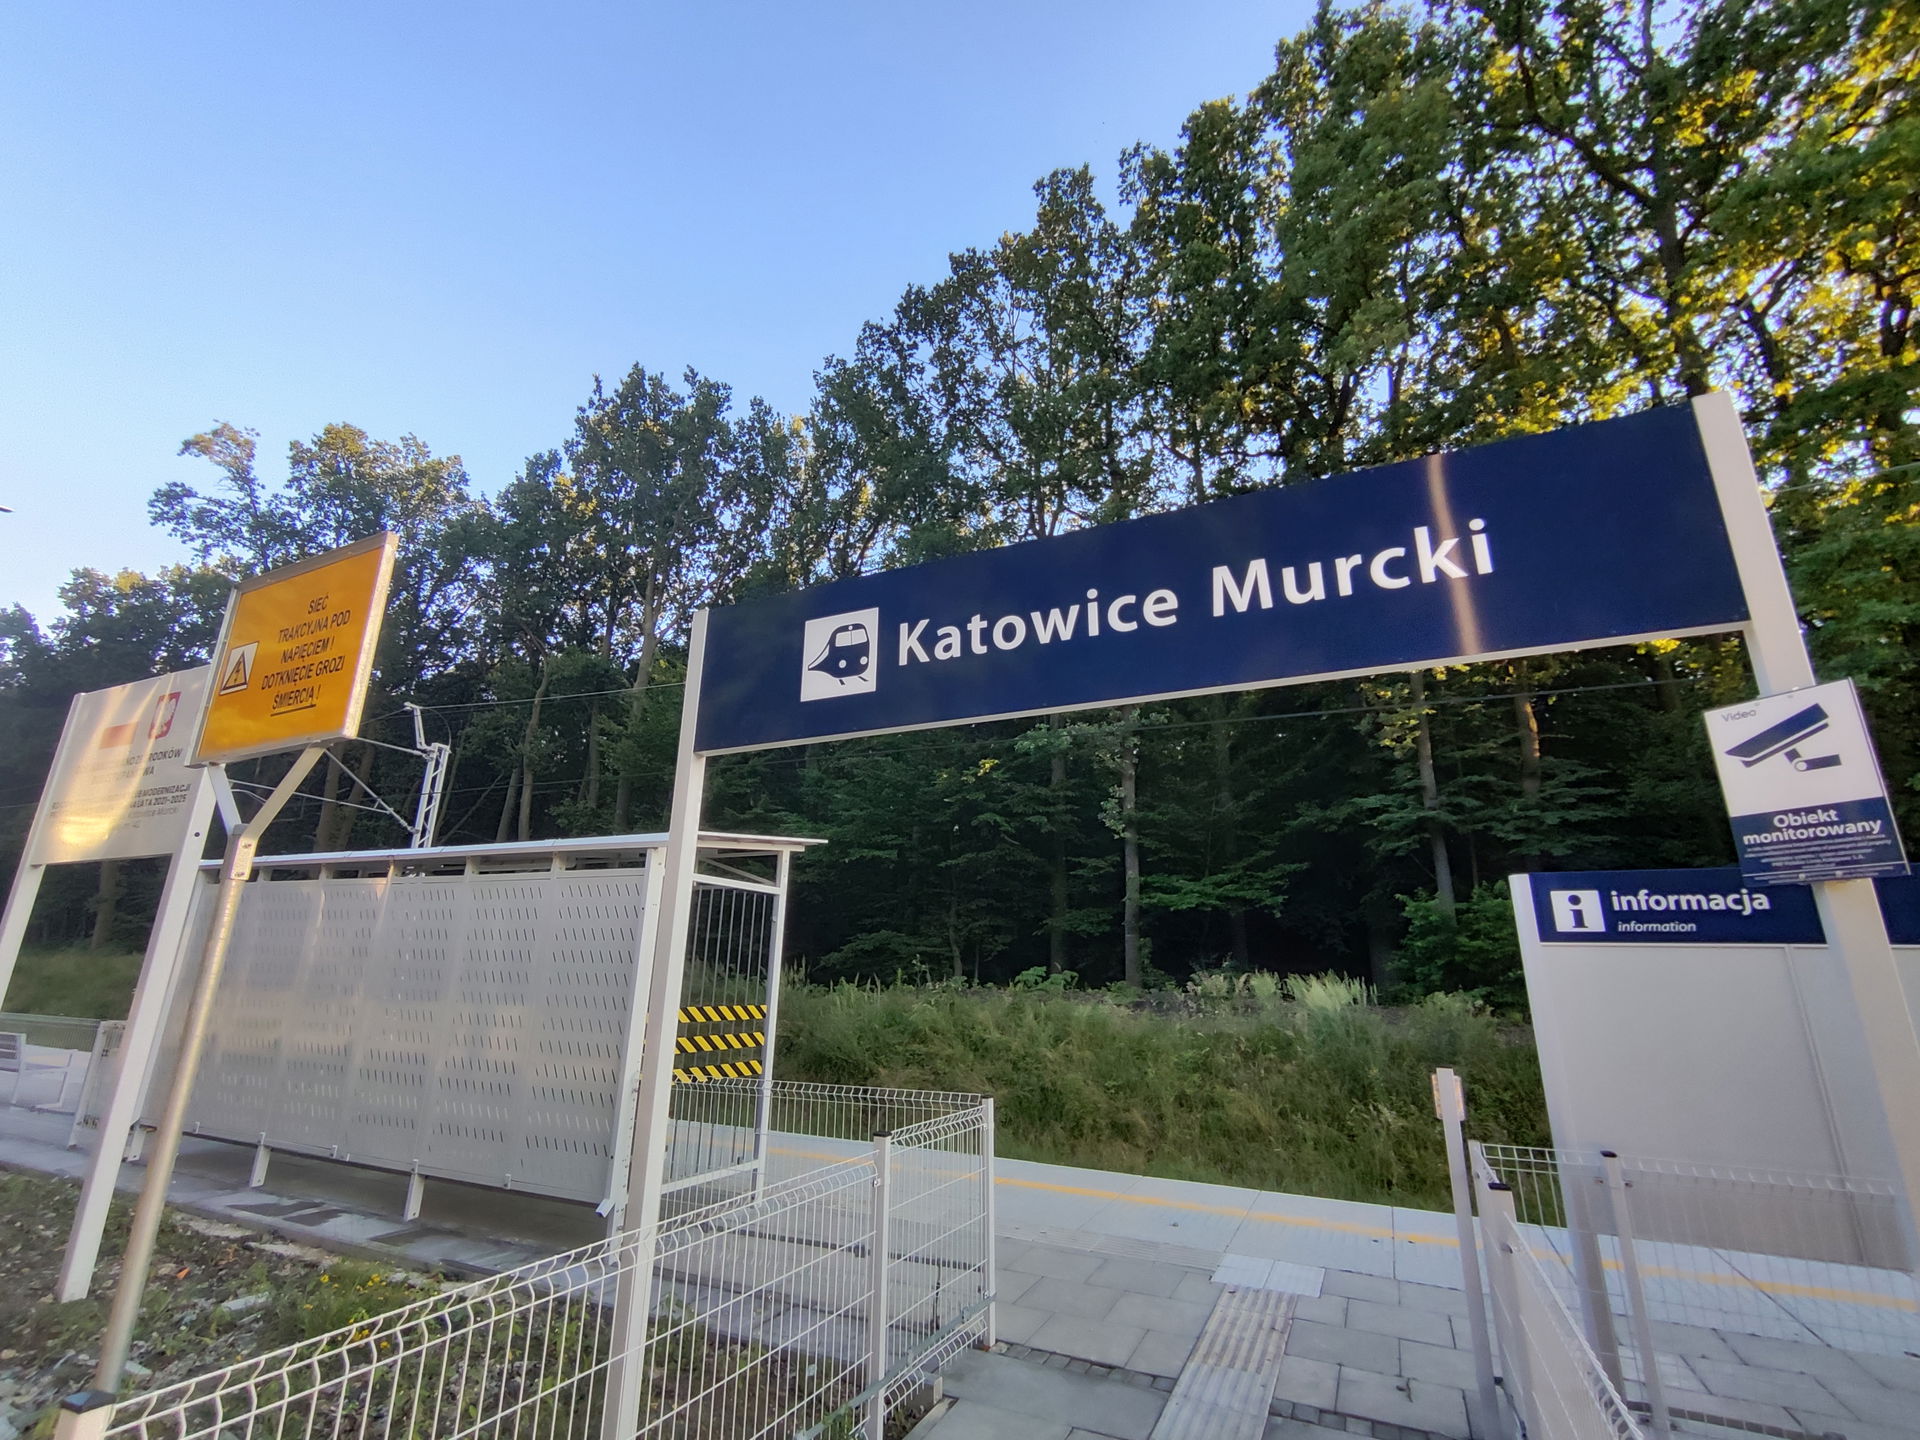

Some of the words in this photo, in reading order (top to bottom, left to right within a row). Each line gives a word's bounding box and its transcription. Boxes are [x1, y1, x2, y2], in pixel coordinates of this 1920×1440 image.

[899, 588, 1179, 666] Katowice
[1212, 518, 1493, 617] Murcki
[278, 616, 329, 643] TRAKCYJNA
[330, 609, 351, 628] POD
[261, 663, 315, 690] DOTKNIĘCIE
[315, 655, 345, 677] GROZI
[1721, 708, 1757, 723] Video
[1743, 819, 1882, 846] monitorowany
[1773, 809, 1839, 829] Obiekt
[1610, 888, 1771, 916] informacja
[1617, 919, 1698, 934] information
